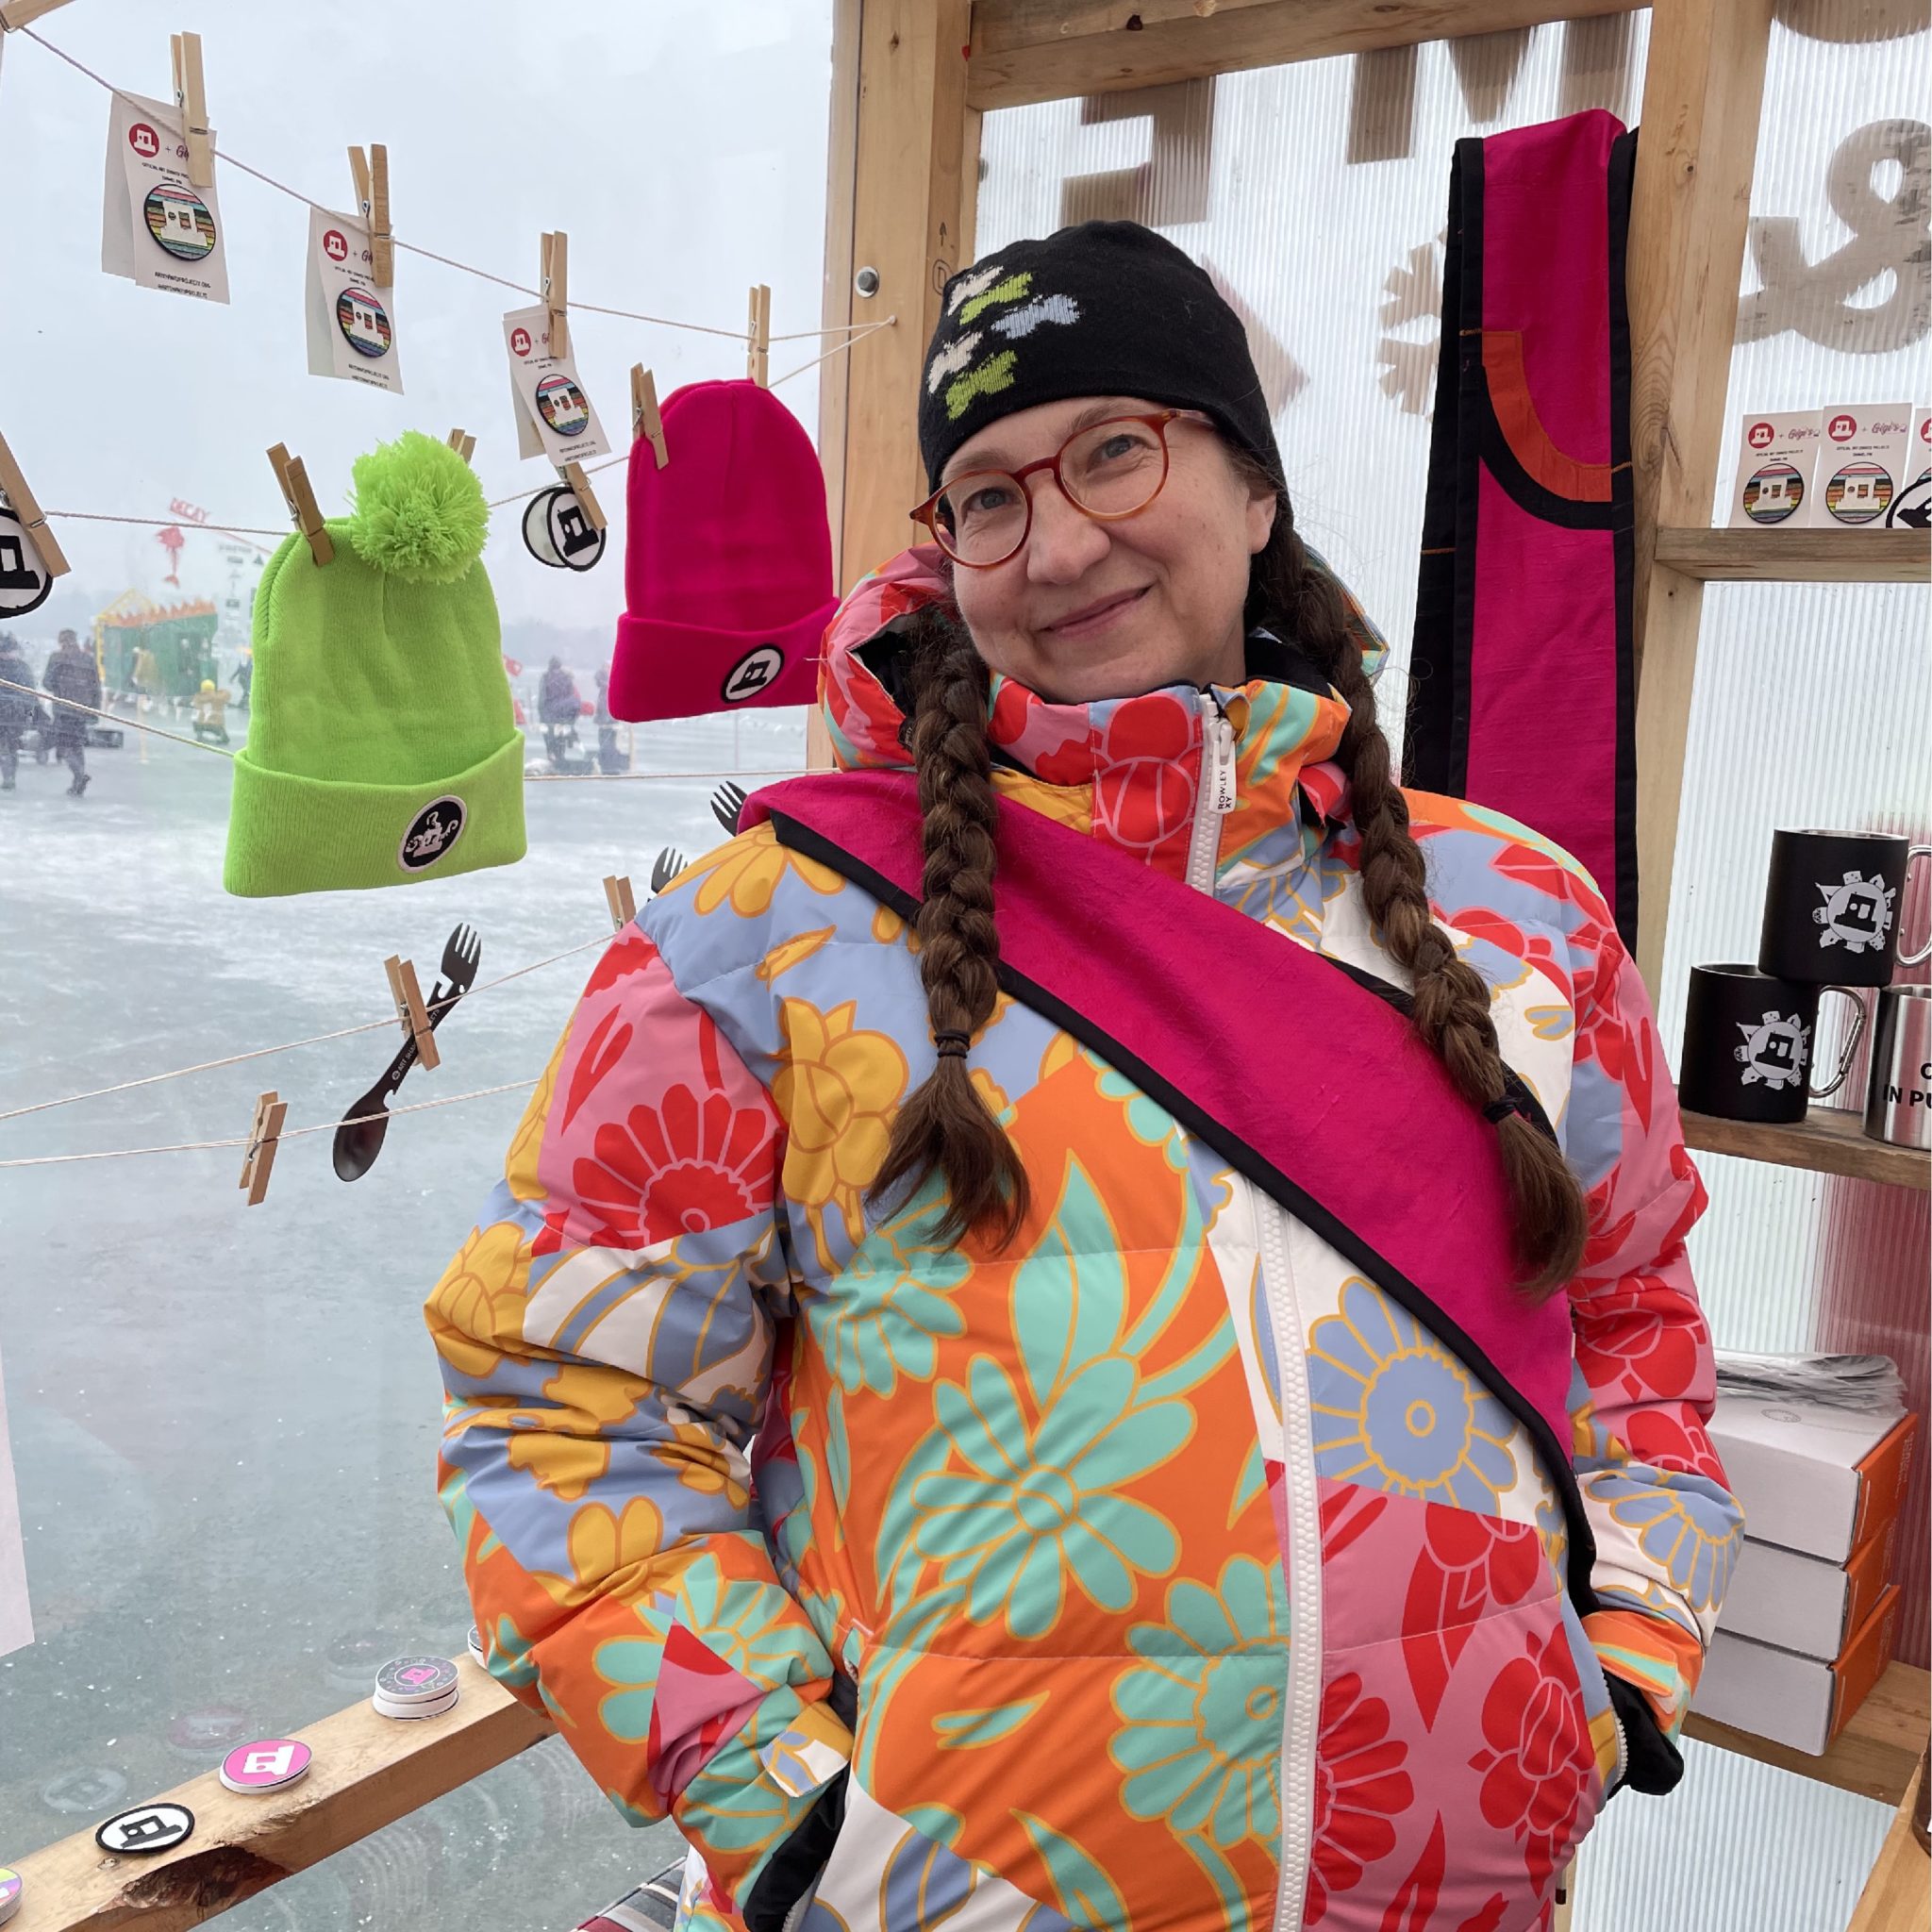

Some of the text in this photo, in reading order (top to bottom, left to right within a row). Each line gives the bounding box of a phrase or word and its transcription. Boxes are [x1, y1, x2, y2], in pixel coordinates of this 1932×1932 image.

[1218, 770, 1226, 809] ROWLEY
[1224, 796, 1232, 809] XY
[1883, 1084, 1903, 1105] IN
